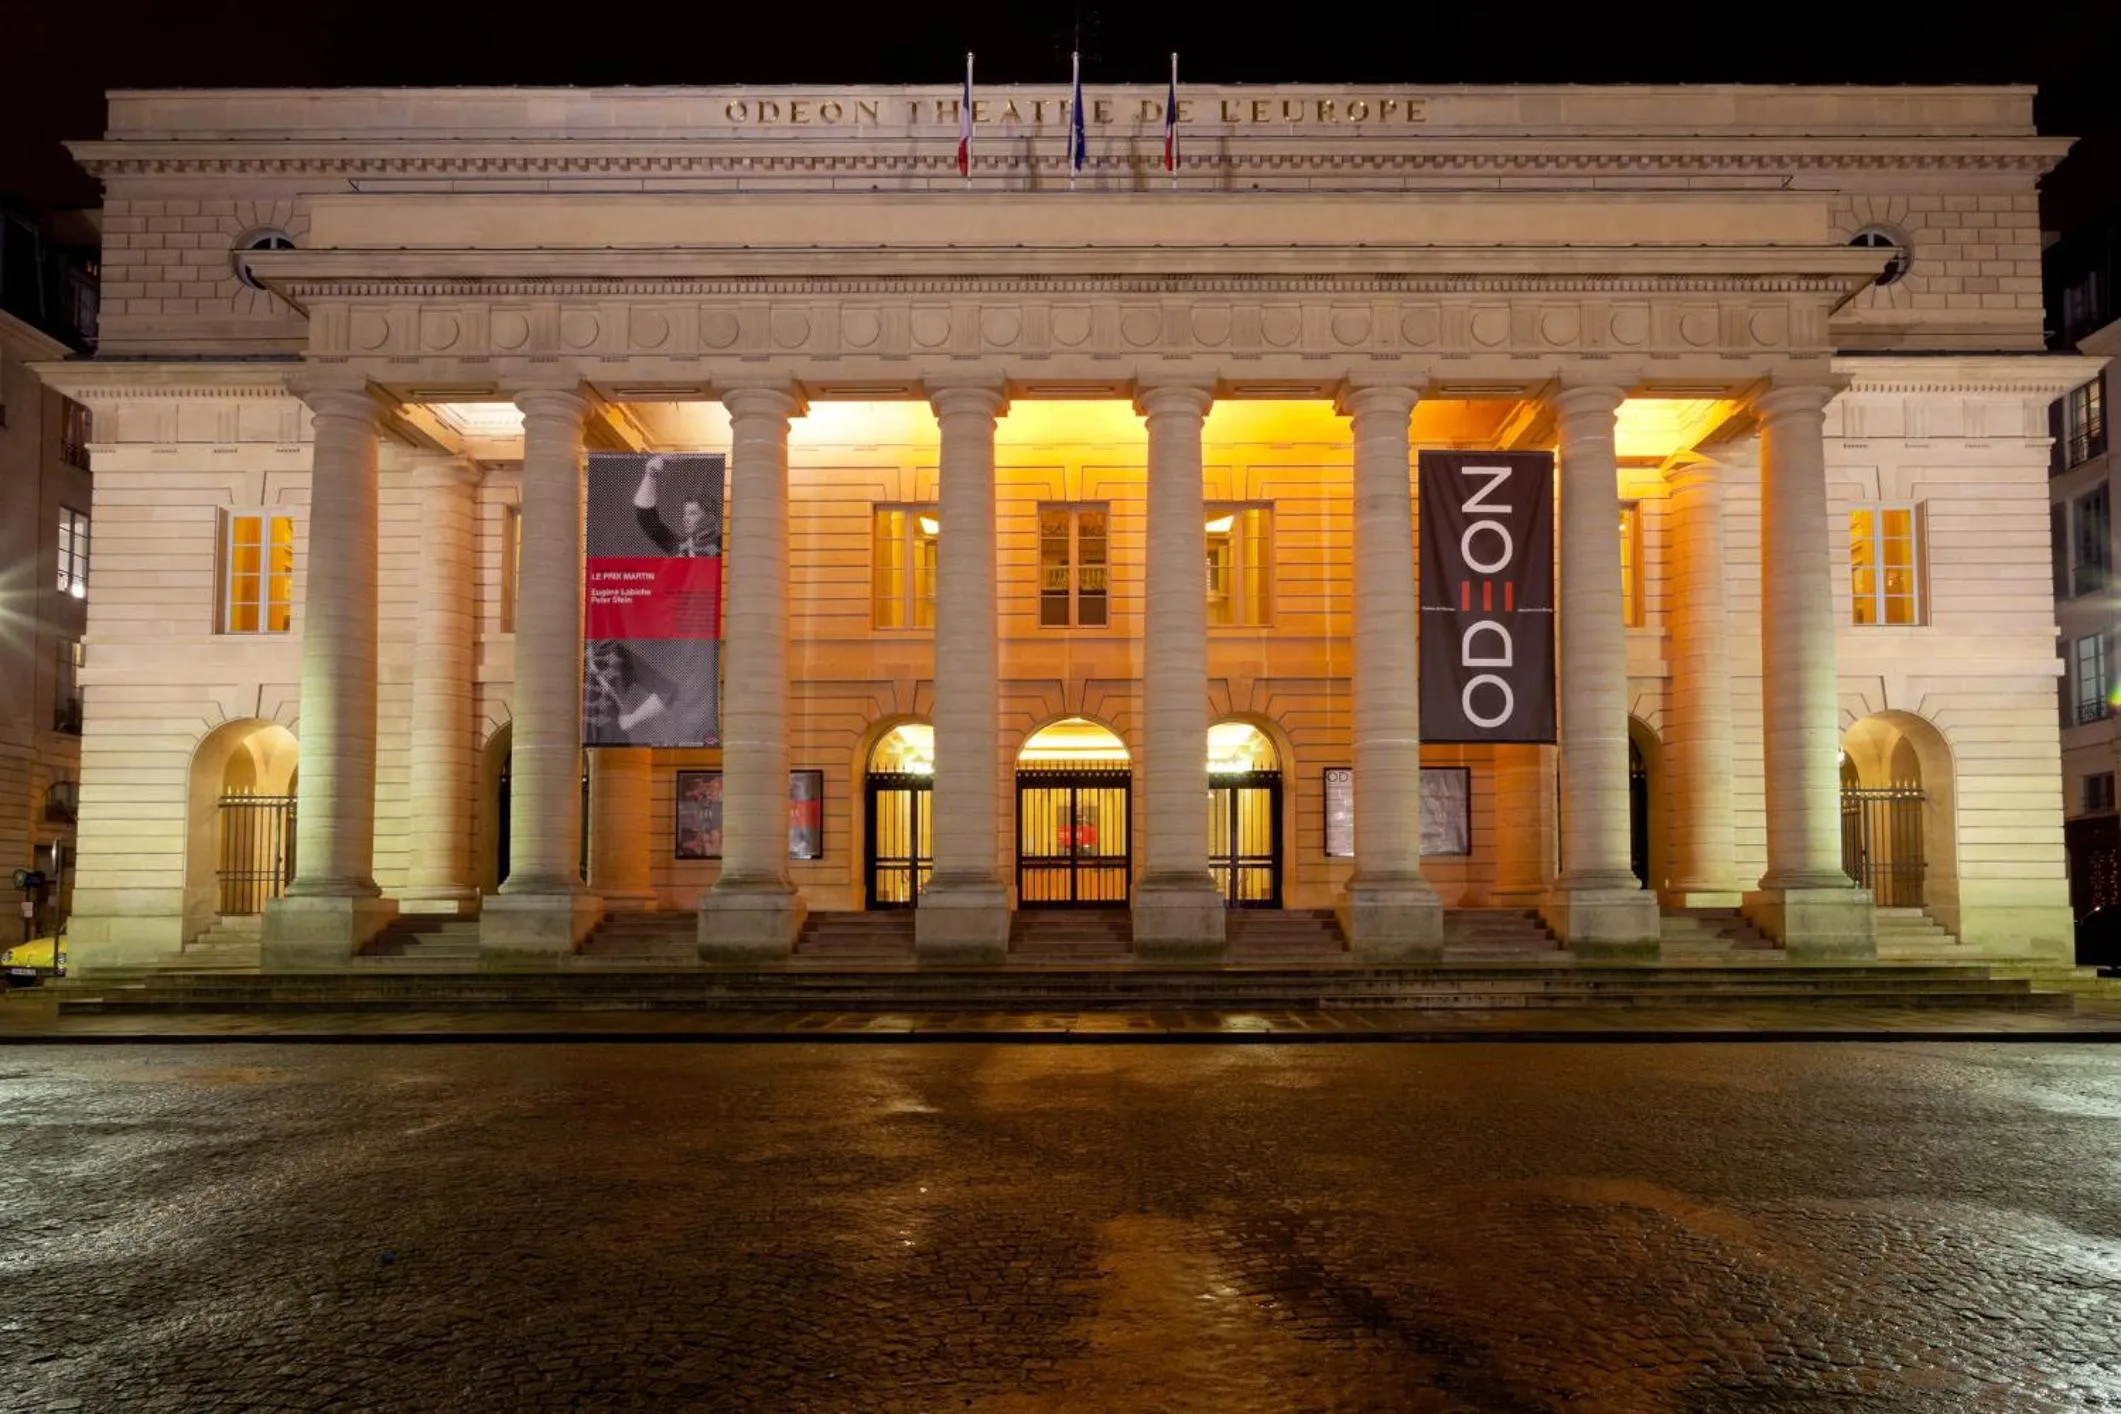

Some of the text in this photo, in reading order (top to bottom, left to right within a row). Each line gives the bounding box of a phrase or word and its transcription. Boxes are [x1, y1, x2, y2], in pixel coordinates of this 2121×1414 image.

[725, 100, 880, 124] ODEON
[1140, 100, 1194, 123] DE
[1220, 99, 1428, 124] L'EUROPE
[1461, 466, 1514, 728] ODEON
